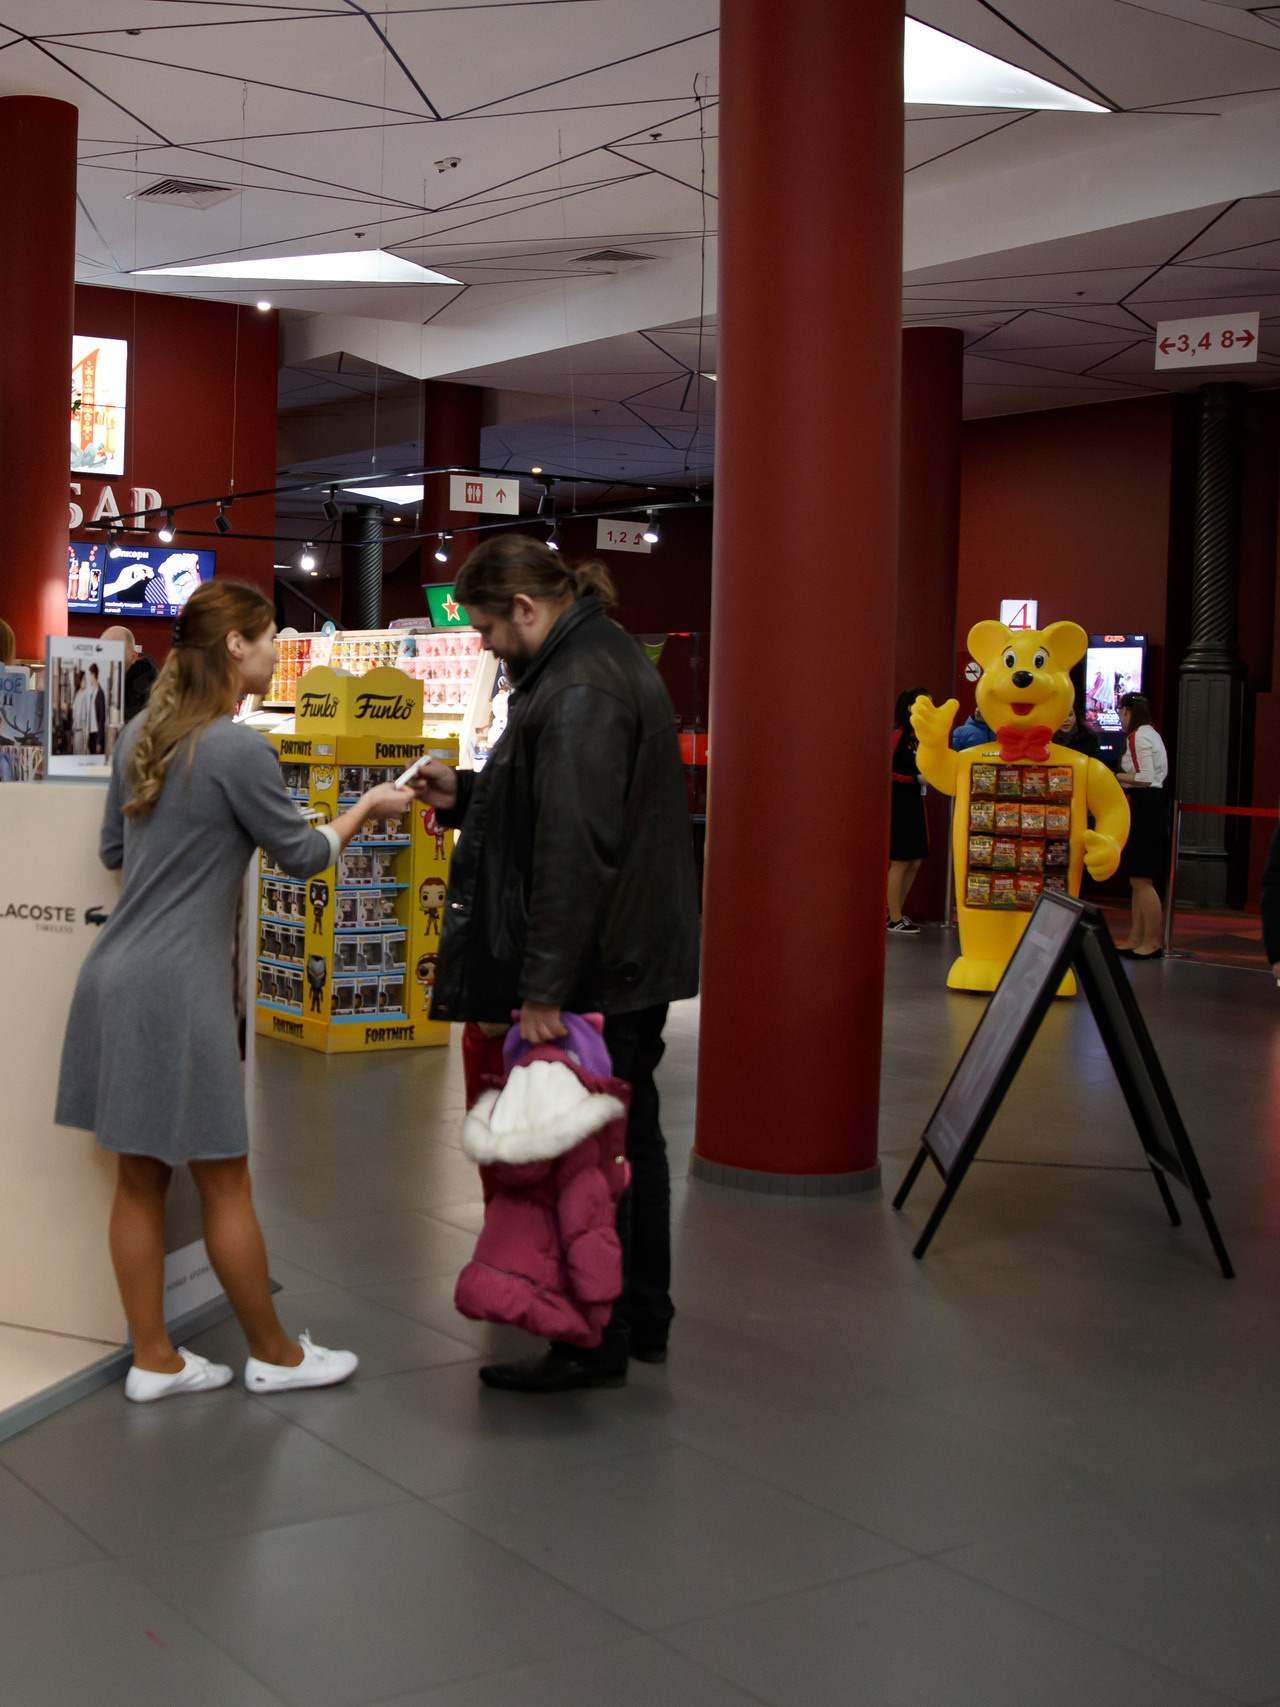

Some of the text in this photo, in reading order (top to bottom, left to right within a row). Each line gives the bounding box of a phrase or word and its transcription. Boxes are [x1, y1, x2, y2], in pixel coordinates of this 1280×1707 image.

[1177, 330, 1234, 356] 3,4 8
[606, 530, 627, 544] 1,2
[1008, 603, 1031, 630] 4
[299, 692, 339, 719] Funko
[354, 693, 415, 720] Funko
[280, 739, 313, 756] FORTNITE
[375, 742, 425, 760] FORTNITE
[35, 923, 74, 934] TIMELESS
[273, 1015, 304, 1040] FORTNITE
[365, 1025, 415, 1045] FORTNITE
